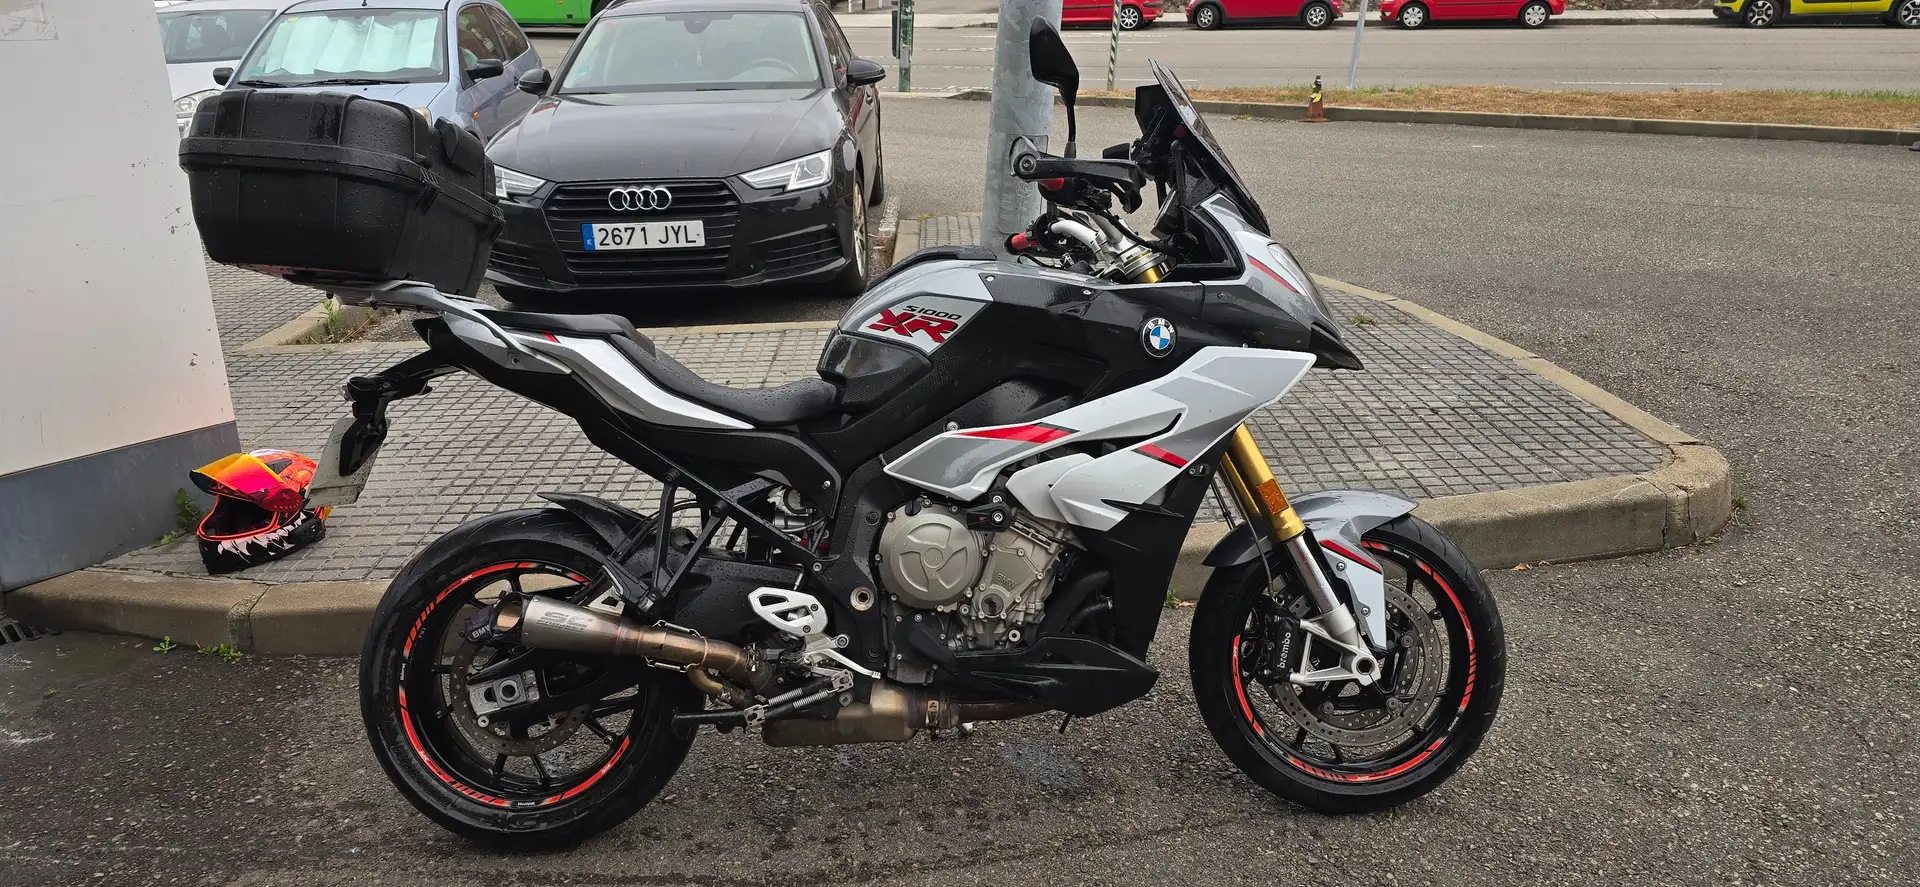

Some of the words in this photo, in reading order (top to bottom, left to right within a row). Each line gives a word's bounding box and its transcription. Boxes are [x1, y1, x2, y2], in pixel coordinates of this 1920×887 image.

[598, 226, 648, 246] 2671
[658, 225, 697, 245] JYL
[903, 305, 962, 320] S1000
[866, 308, 959, 344] XR
[997, 572, 1018, 588] BMW
[471, 624, 491, 639] BMW
[1276, 632, 1292, 669] brembo
